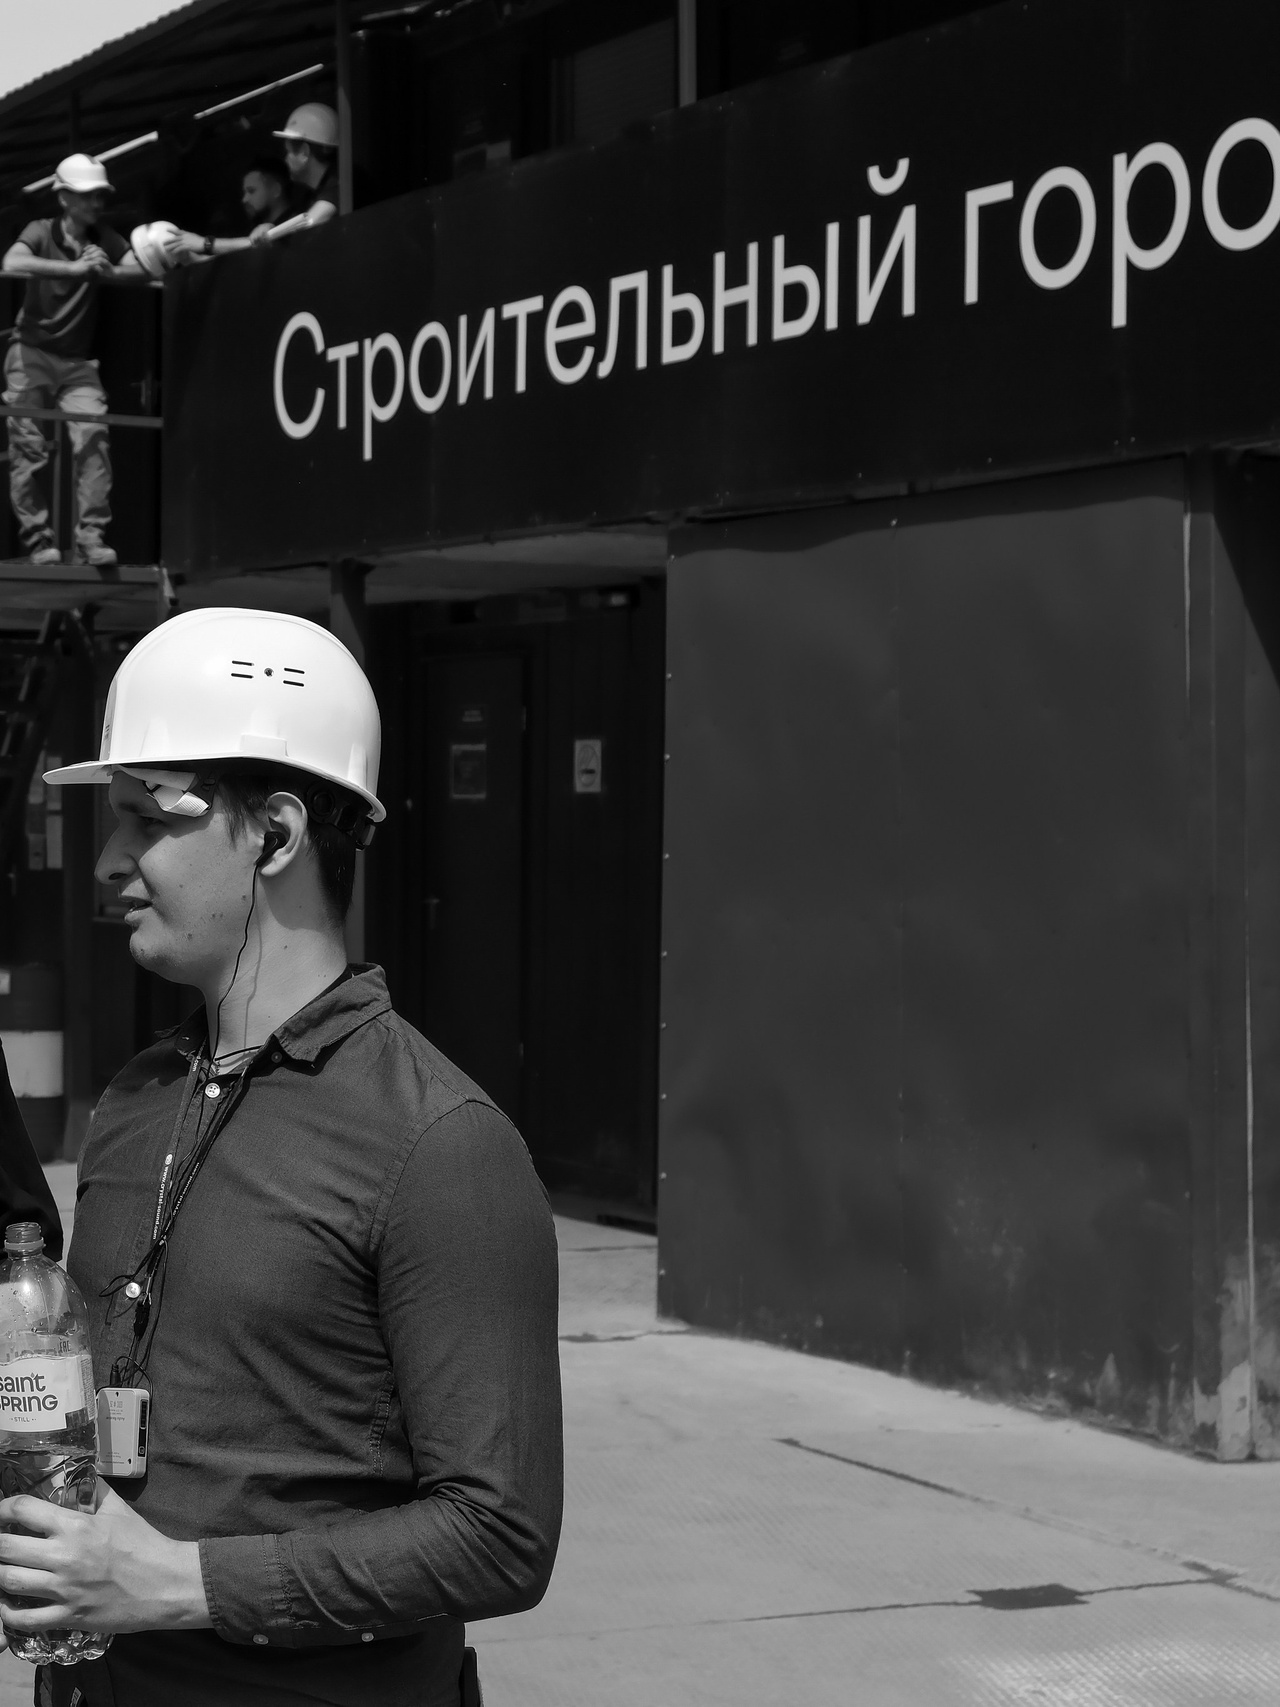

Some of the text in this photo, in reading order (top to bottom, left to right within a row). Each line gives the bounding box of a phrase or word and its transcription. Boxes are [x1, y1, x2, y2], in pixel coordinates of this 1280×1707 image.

[274, 118, 1280, 461] Строительный горо
[152, 1166, 170, 1240] www.crystal-sound.com
